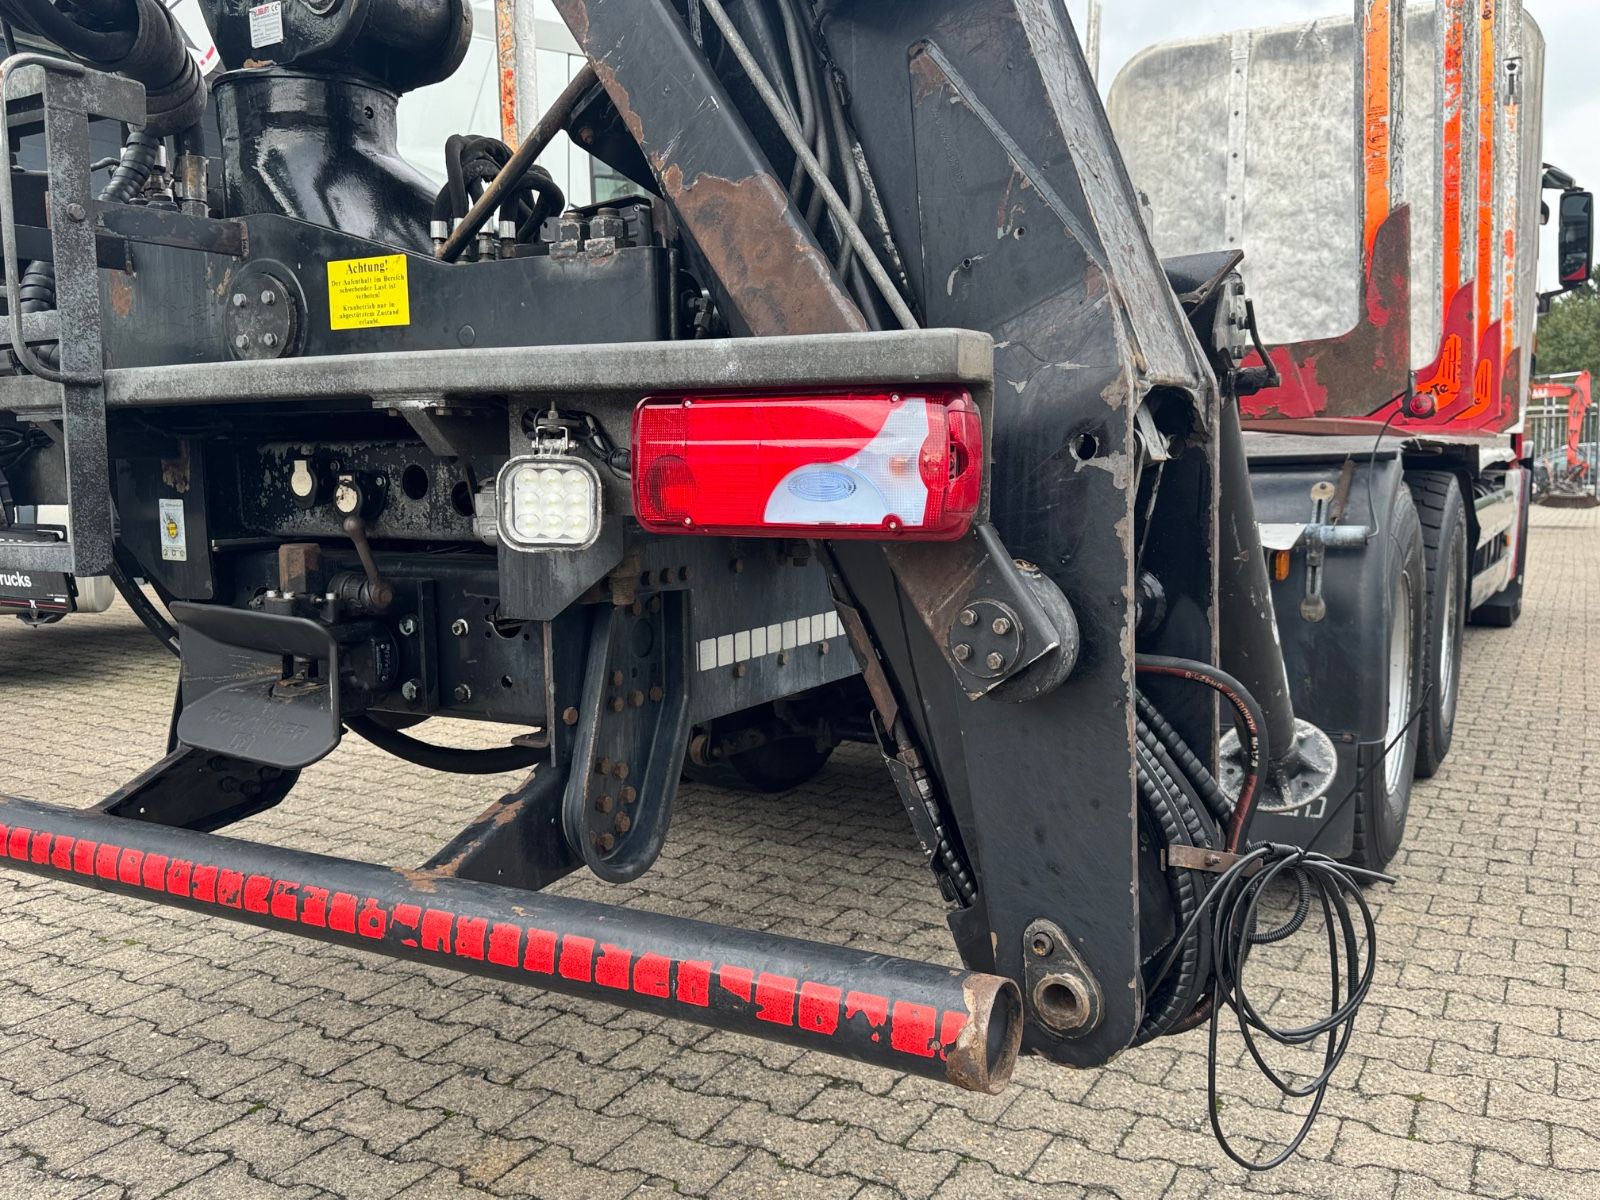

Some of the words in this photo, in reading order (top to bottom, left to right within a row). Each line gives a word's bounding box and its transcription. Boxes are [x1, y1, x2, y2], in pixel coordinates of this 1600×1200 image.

[347, 259, 388, 274] Achtung!
[343, 277, 372, 286] Aufenthalt
[340, 284, 372, 293] schwebender
[374, 283, 388, 291] Last
[343, 303, 375, 311] Kranbetrieb
[0, 571, 32, 588] rucks
